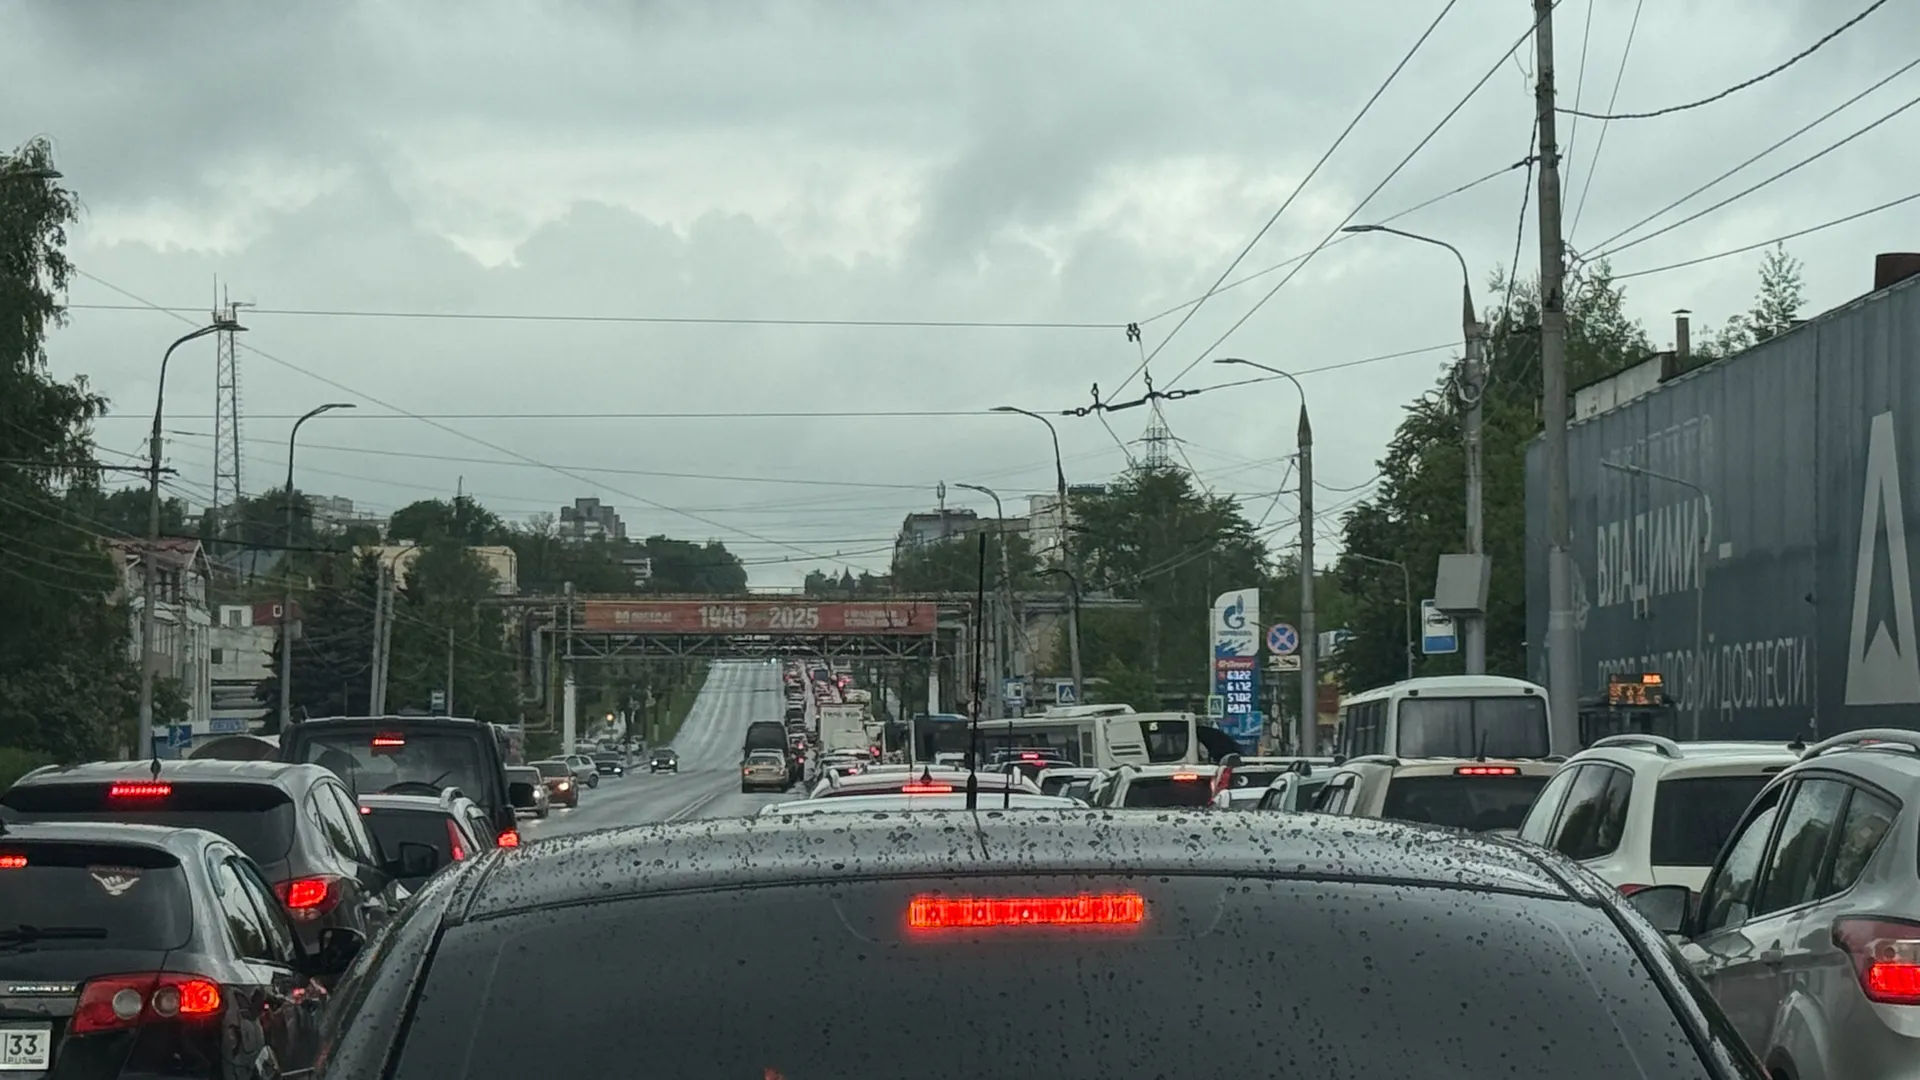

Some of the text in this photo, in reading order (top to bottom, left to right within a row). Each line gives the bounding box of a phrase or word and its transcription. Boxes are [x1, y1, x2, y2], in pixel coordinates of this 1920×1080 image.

[699, 606, 746, 628] 1945
[769, 607, 819, 629] 2025
[1720, 637, 1807, 722] ДОБЛЕСТИ
[10, 1034, 38, 1055] 33
